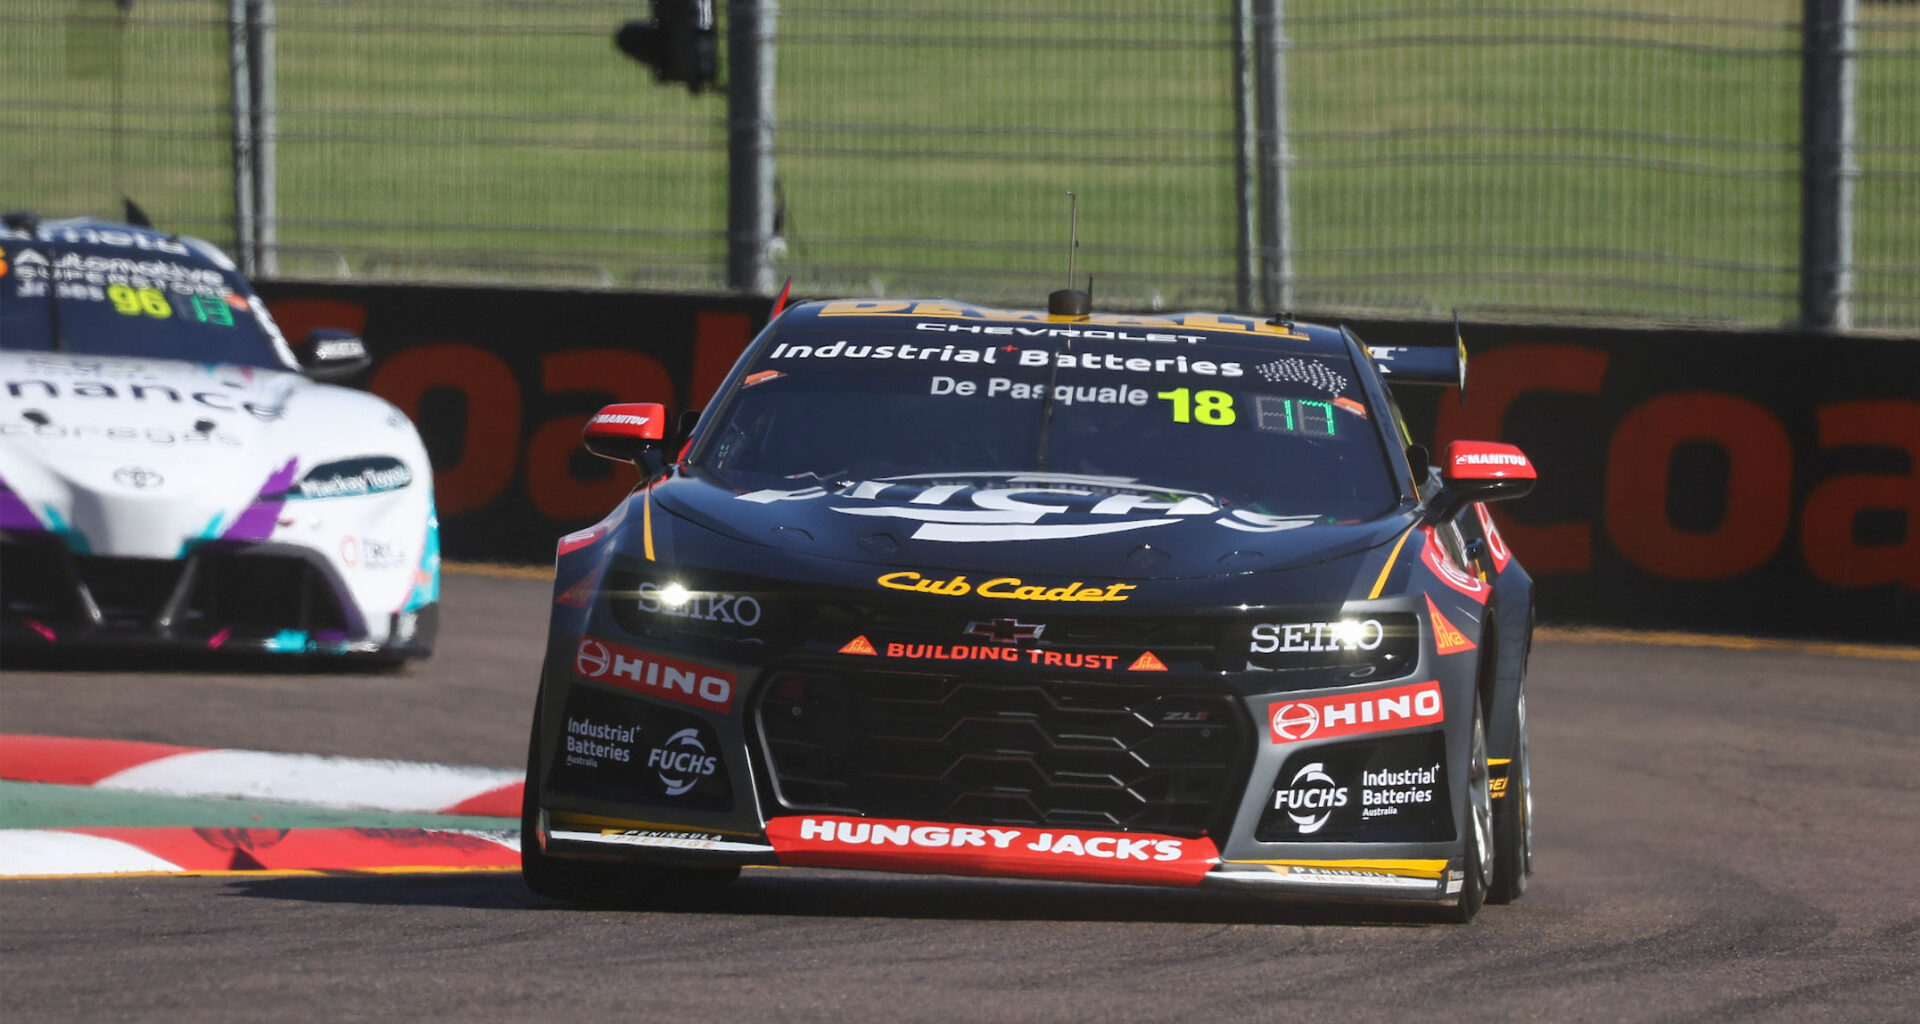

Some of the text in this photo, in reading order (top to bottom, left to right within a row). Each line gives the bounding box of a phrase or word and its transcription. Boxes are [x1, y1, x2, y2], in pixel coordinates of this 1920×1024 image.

[107, 284, 173, 319] 96
[916, 322, 1207, 344] CHEVROLET
[1019, 349, 1244, 377] Batteries
[931, 376, 1236, 426] De Pasquale 18
[597, 413, 650, 426] MANITOU
[1467, 453, 1526, 467] MANITOU
[877, 571, 1137, 602] Cub Cadet
[637, 582, 762, 628] SEIKO
[1430, 612, 1465, 649] Sika
[844, 639, 872, 653] Sika
[887, 643, 1119, 670] BUILDING TRUST
[1135, 655, 1162, 670] Sika
[612, 653, 730, 703] HINO
[1323, 689, 1440, 728] HINO
[566, 736, 630, 763] Batteries
[648, 747, 717, 776] FUCHS
[1274, 787, 1348, 810] FUCHS
[1362, 786, 1433, 806] Batteries
[1361, 806, 1398, 818] Australia
[623, 829, 722, 842] PENINSULA
[801, 818, 1182, 862] HUNGRY JACK'S
[1292, 865, 1398, 878] PENINSULA
